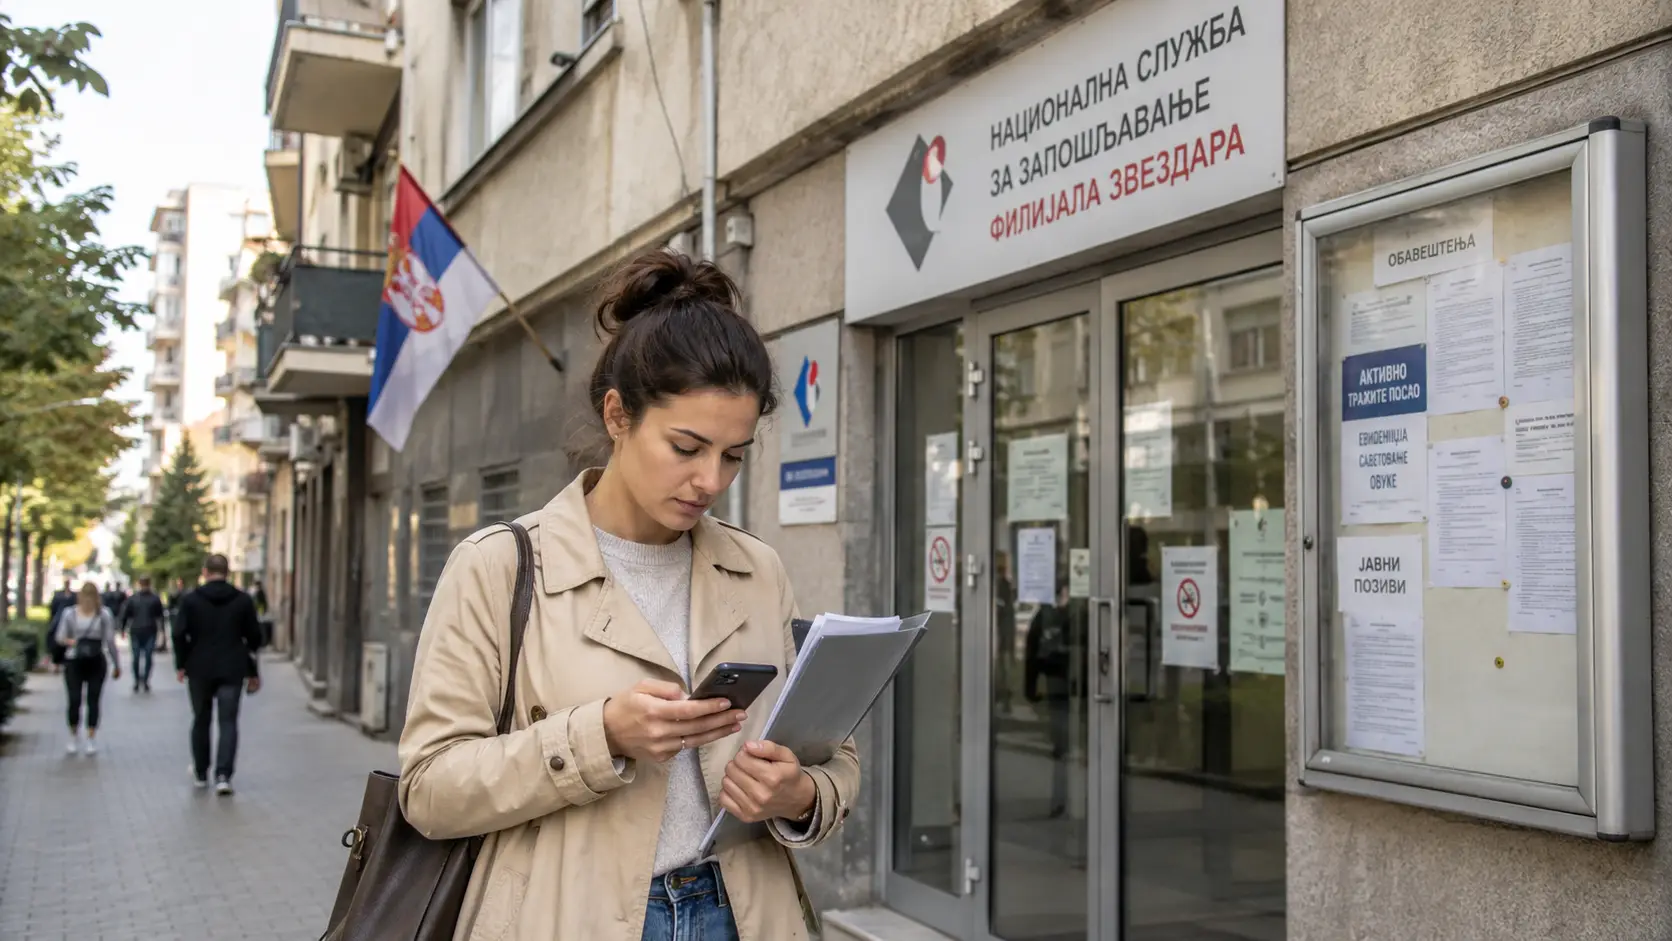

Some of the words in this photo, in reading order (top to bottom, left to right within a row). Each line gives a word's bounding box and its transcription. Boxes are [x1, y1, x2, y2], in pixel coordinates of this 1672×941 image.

[990, 62, 1129, 150] НАЦИОНАЛНА
[1137, 5, 1246, 82] СЛУЖБА
[990, 167, 1014, 197] ЗА
[1019, 77, 1211, 185] ЗАПОШЉАВАЊЕ
[990, 178, 1101, 241] ФИЛИЈАЛА
[1109, 123, 1245, 201] ЗВЕЗДАРА
[1388, 233, 1476, 267] ОБАВЕШТЕЊА
[1359, 363, 1407, 386] АКТИВНО
[1347, 388, 1387, 407] ТРАЖИТЕ
[1389, 383, 1420, 402] ПОСАО
[1370, 473, 1397, 490] ОВУКЕ
[1359, 556, 1400, 572] ЈАВНИ
[1354, 578, 1406, 594] ПОЗИВИ
